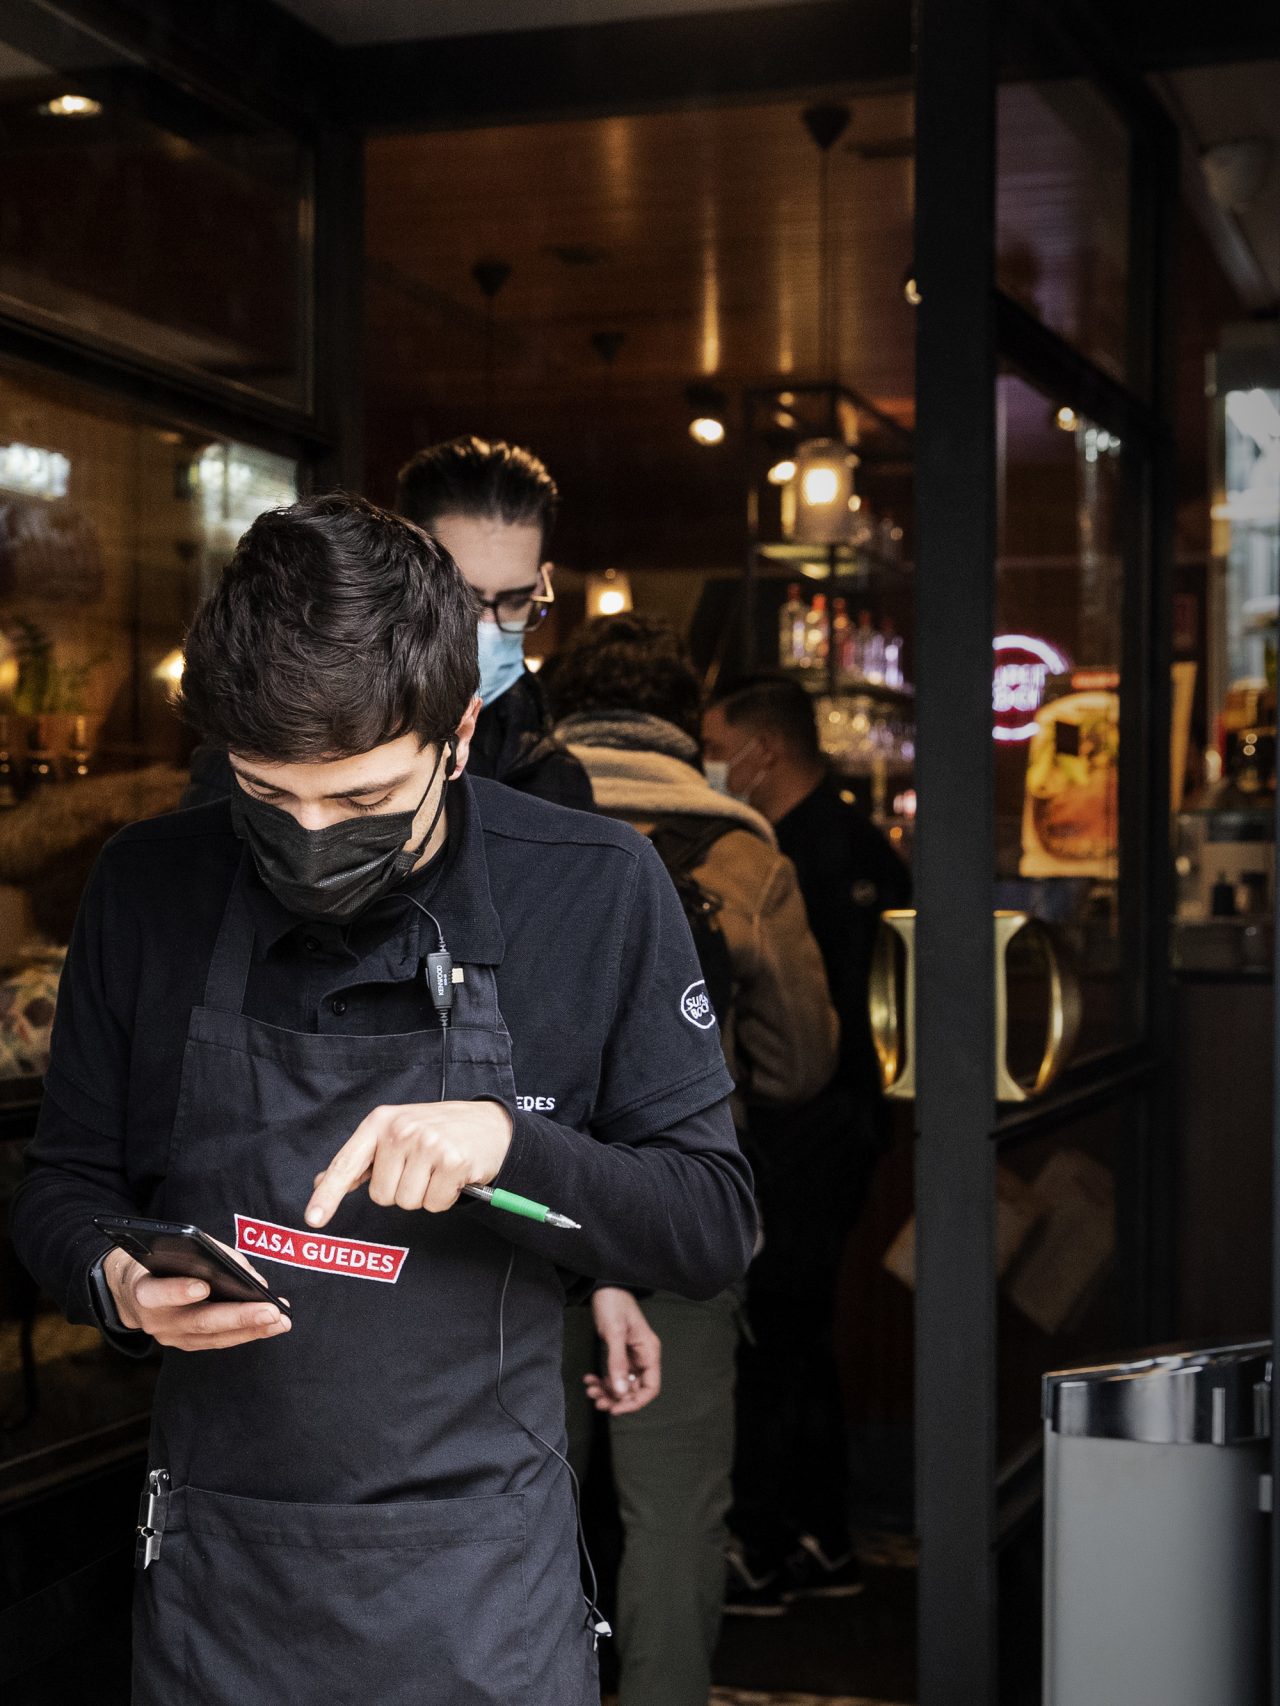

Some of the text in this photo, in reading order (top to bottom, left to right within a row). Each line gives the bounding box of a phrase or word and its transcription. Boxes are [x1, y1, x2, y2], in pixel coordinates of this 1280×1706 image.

[515, 1095, 557, 1112] EDES
[242, 1226, 396, 1274] CASA GUEDES
